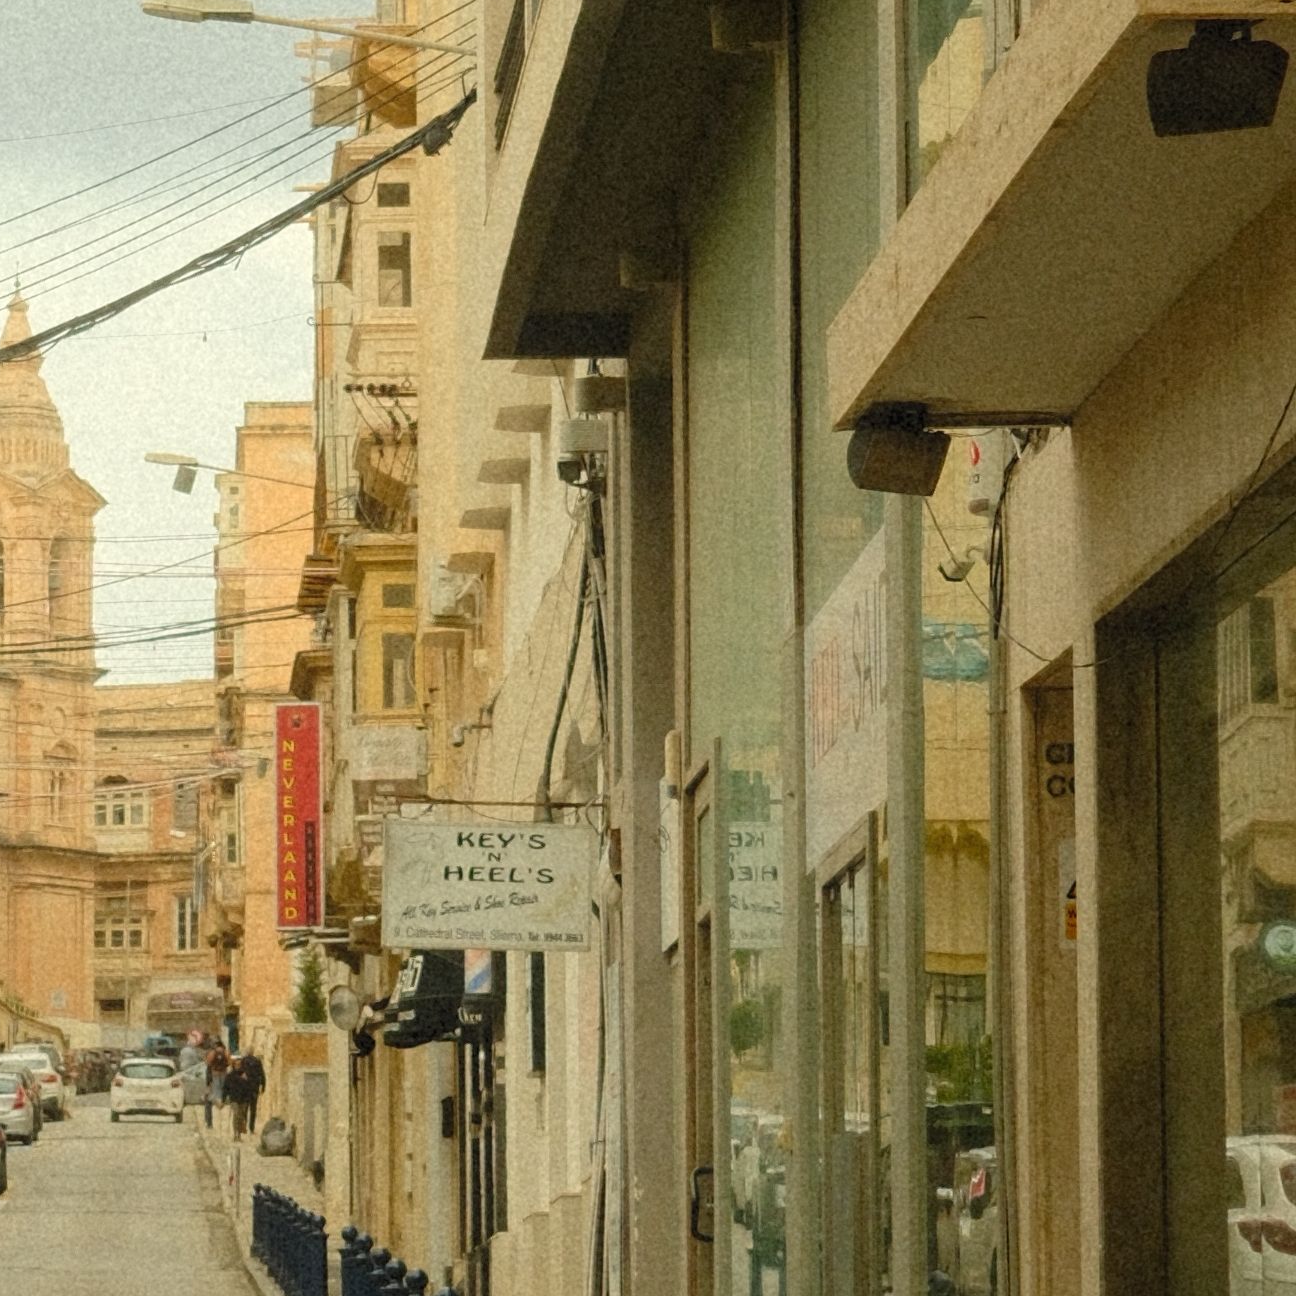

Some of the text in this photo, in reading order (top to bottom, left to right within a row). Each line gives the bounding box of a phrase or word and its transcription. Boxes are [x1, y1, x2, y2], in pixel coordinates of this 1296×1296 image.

[456, 831, 547, 850] KEY'S
[444, 865, 555, 884] HEEL'S
[406, 926, 452, 939] Cathedral
